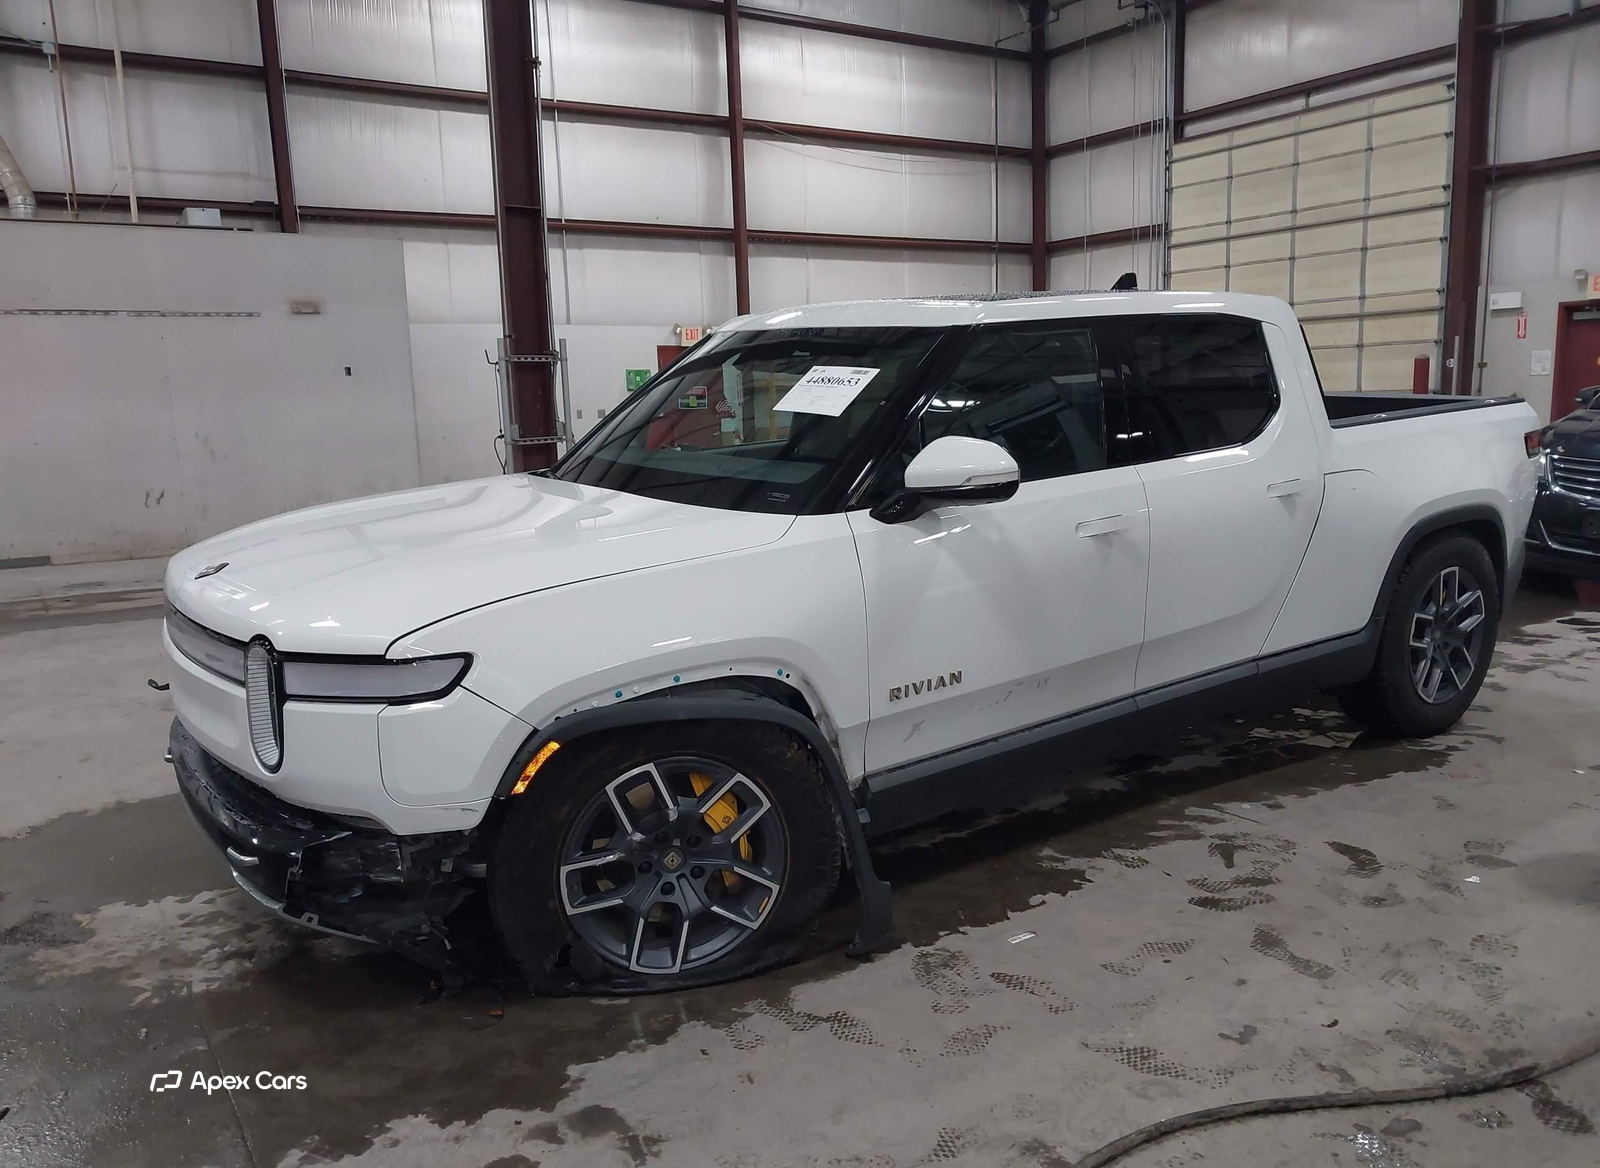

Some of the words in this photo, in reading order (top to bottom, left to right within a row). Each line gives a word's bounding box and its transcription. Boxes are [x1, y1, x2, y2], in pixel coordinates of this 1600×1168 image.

[685, 328, 699, 341] EXIT
[805, 375, 861, 387] 44880653
[889, 670, 962, 702] RIVIAN
